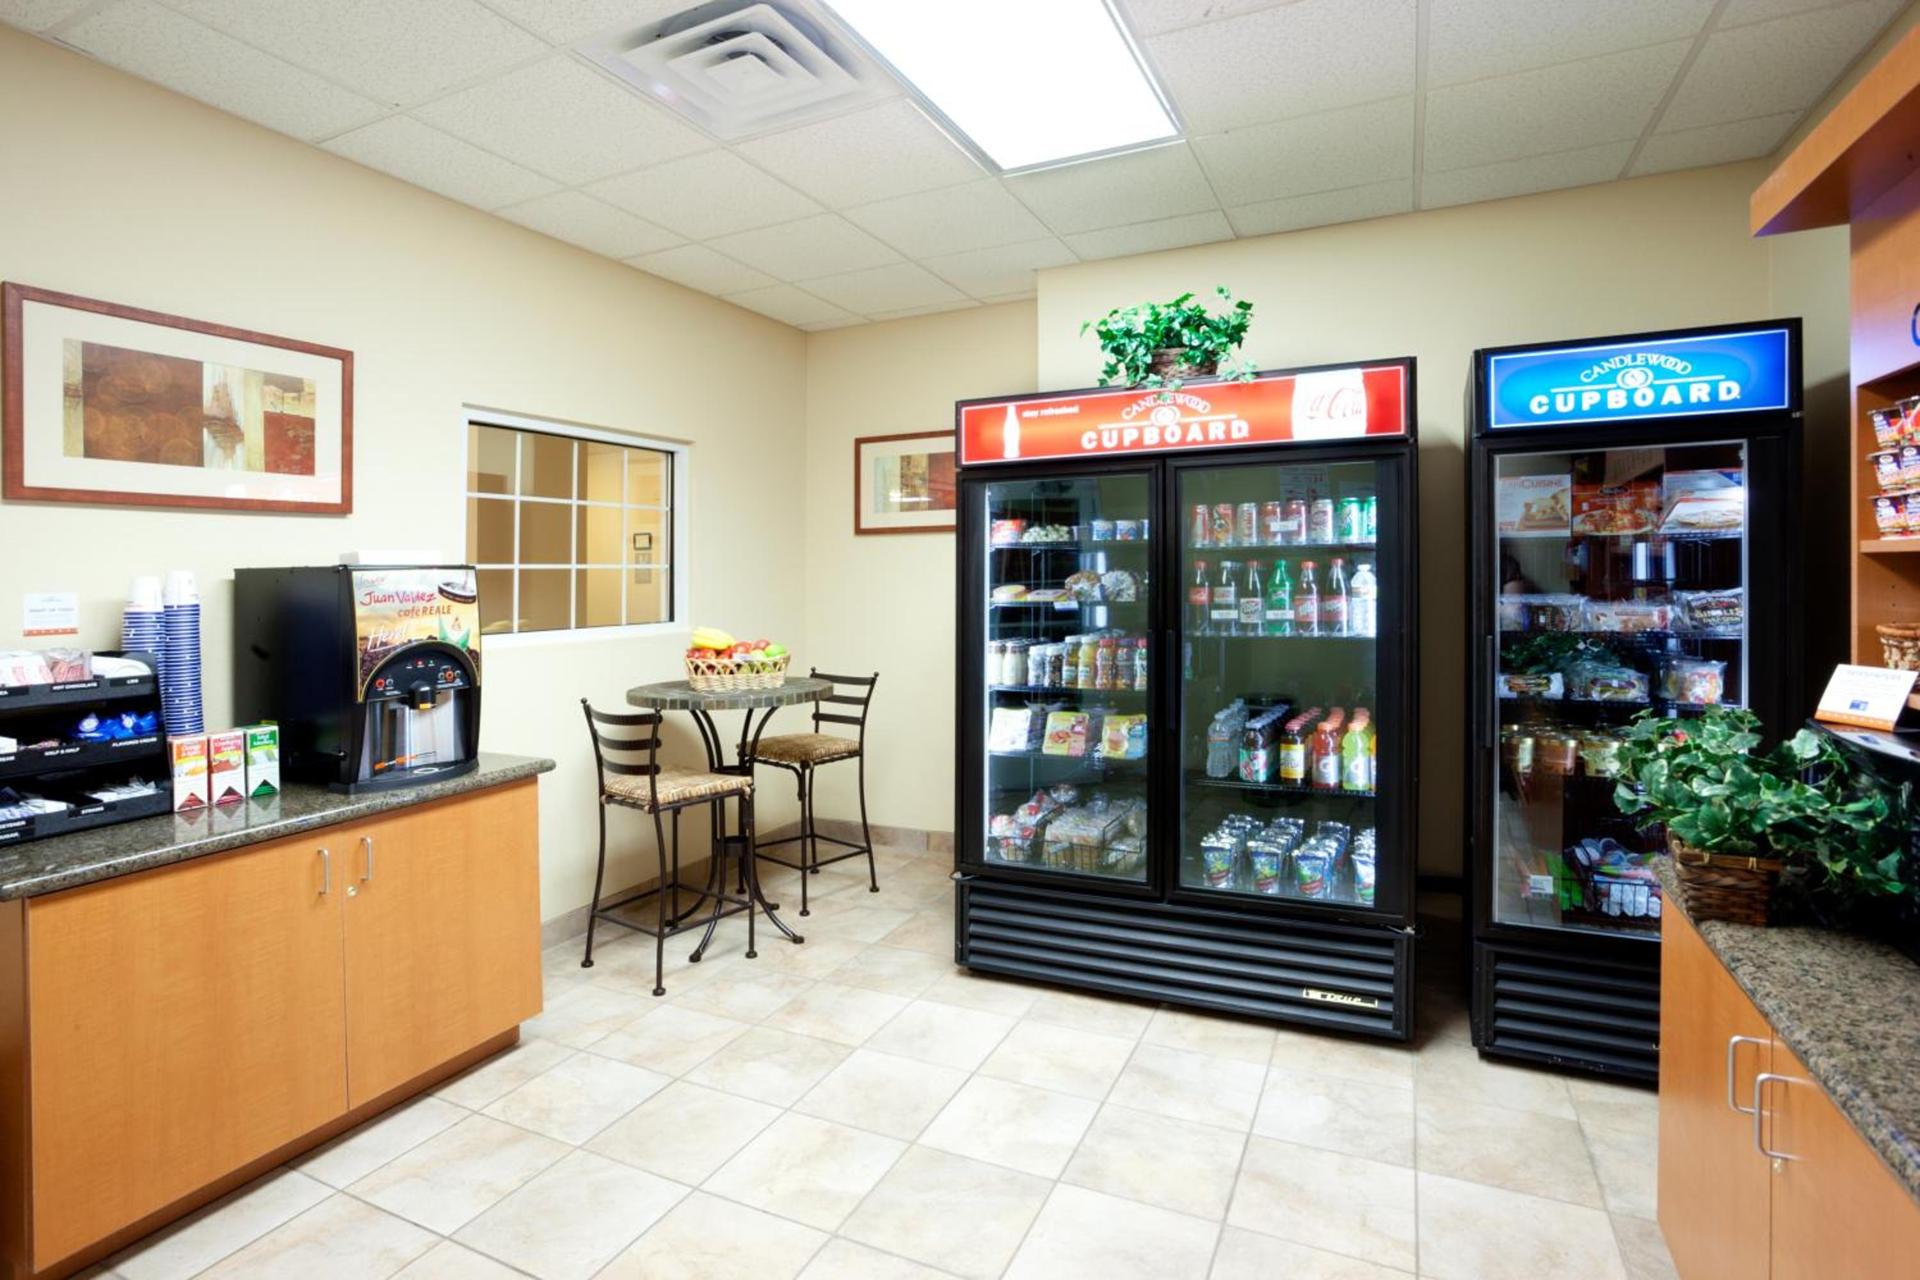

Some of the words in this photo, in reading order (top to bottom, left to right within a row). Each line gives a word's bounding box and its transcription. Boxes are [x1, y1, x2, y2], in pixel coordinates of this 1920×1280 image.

[1580, 353, 1692, 383] CANDLEWOOD
[1122, 391, 1211, 420] CANDEWOOD
[1530, 381, 1739, 414] CUPBOARD
[1081, 420, 1249, 449] CUPBOARD
[360, 591, 395, 606] Juan
